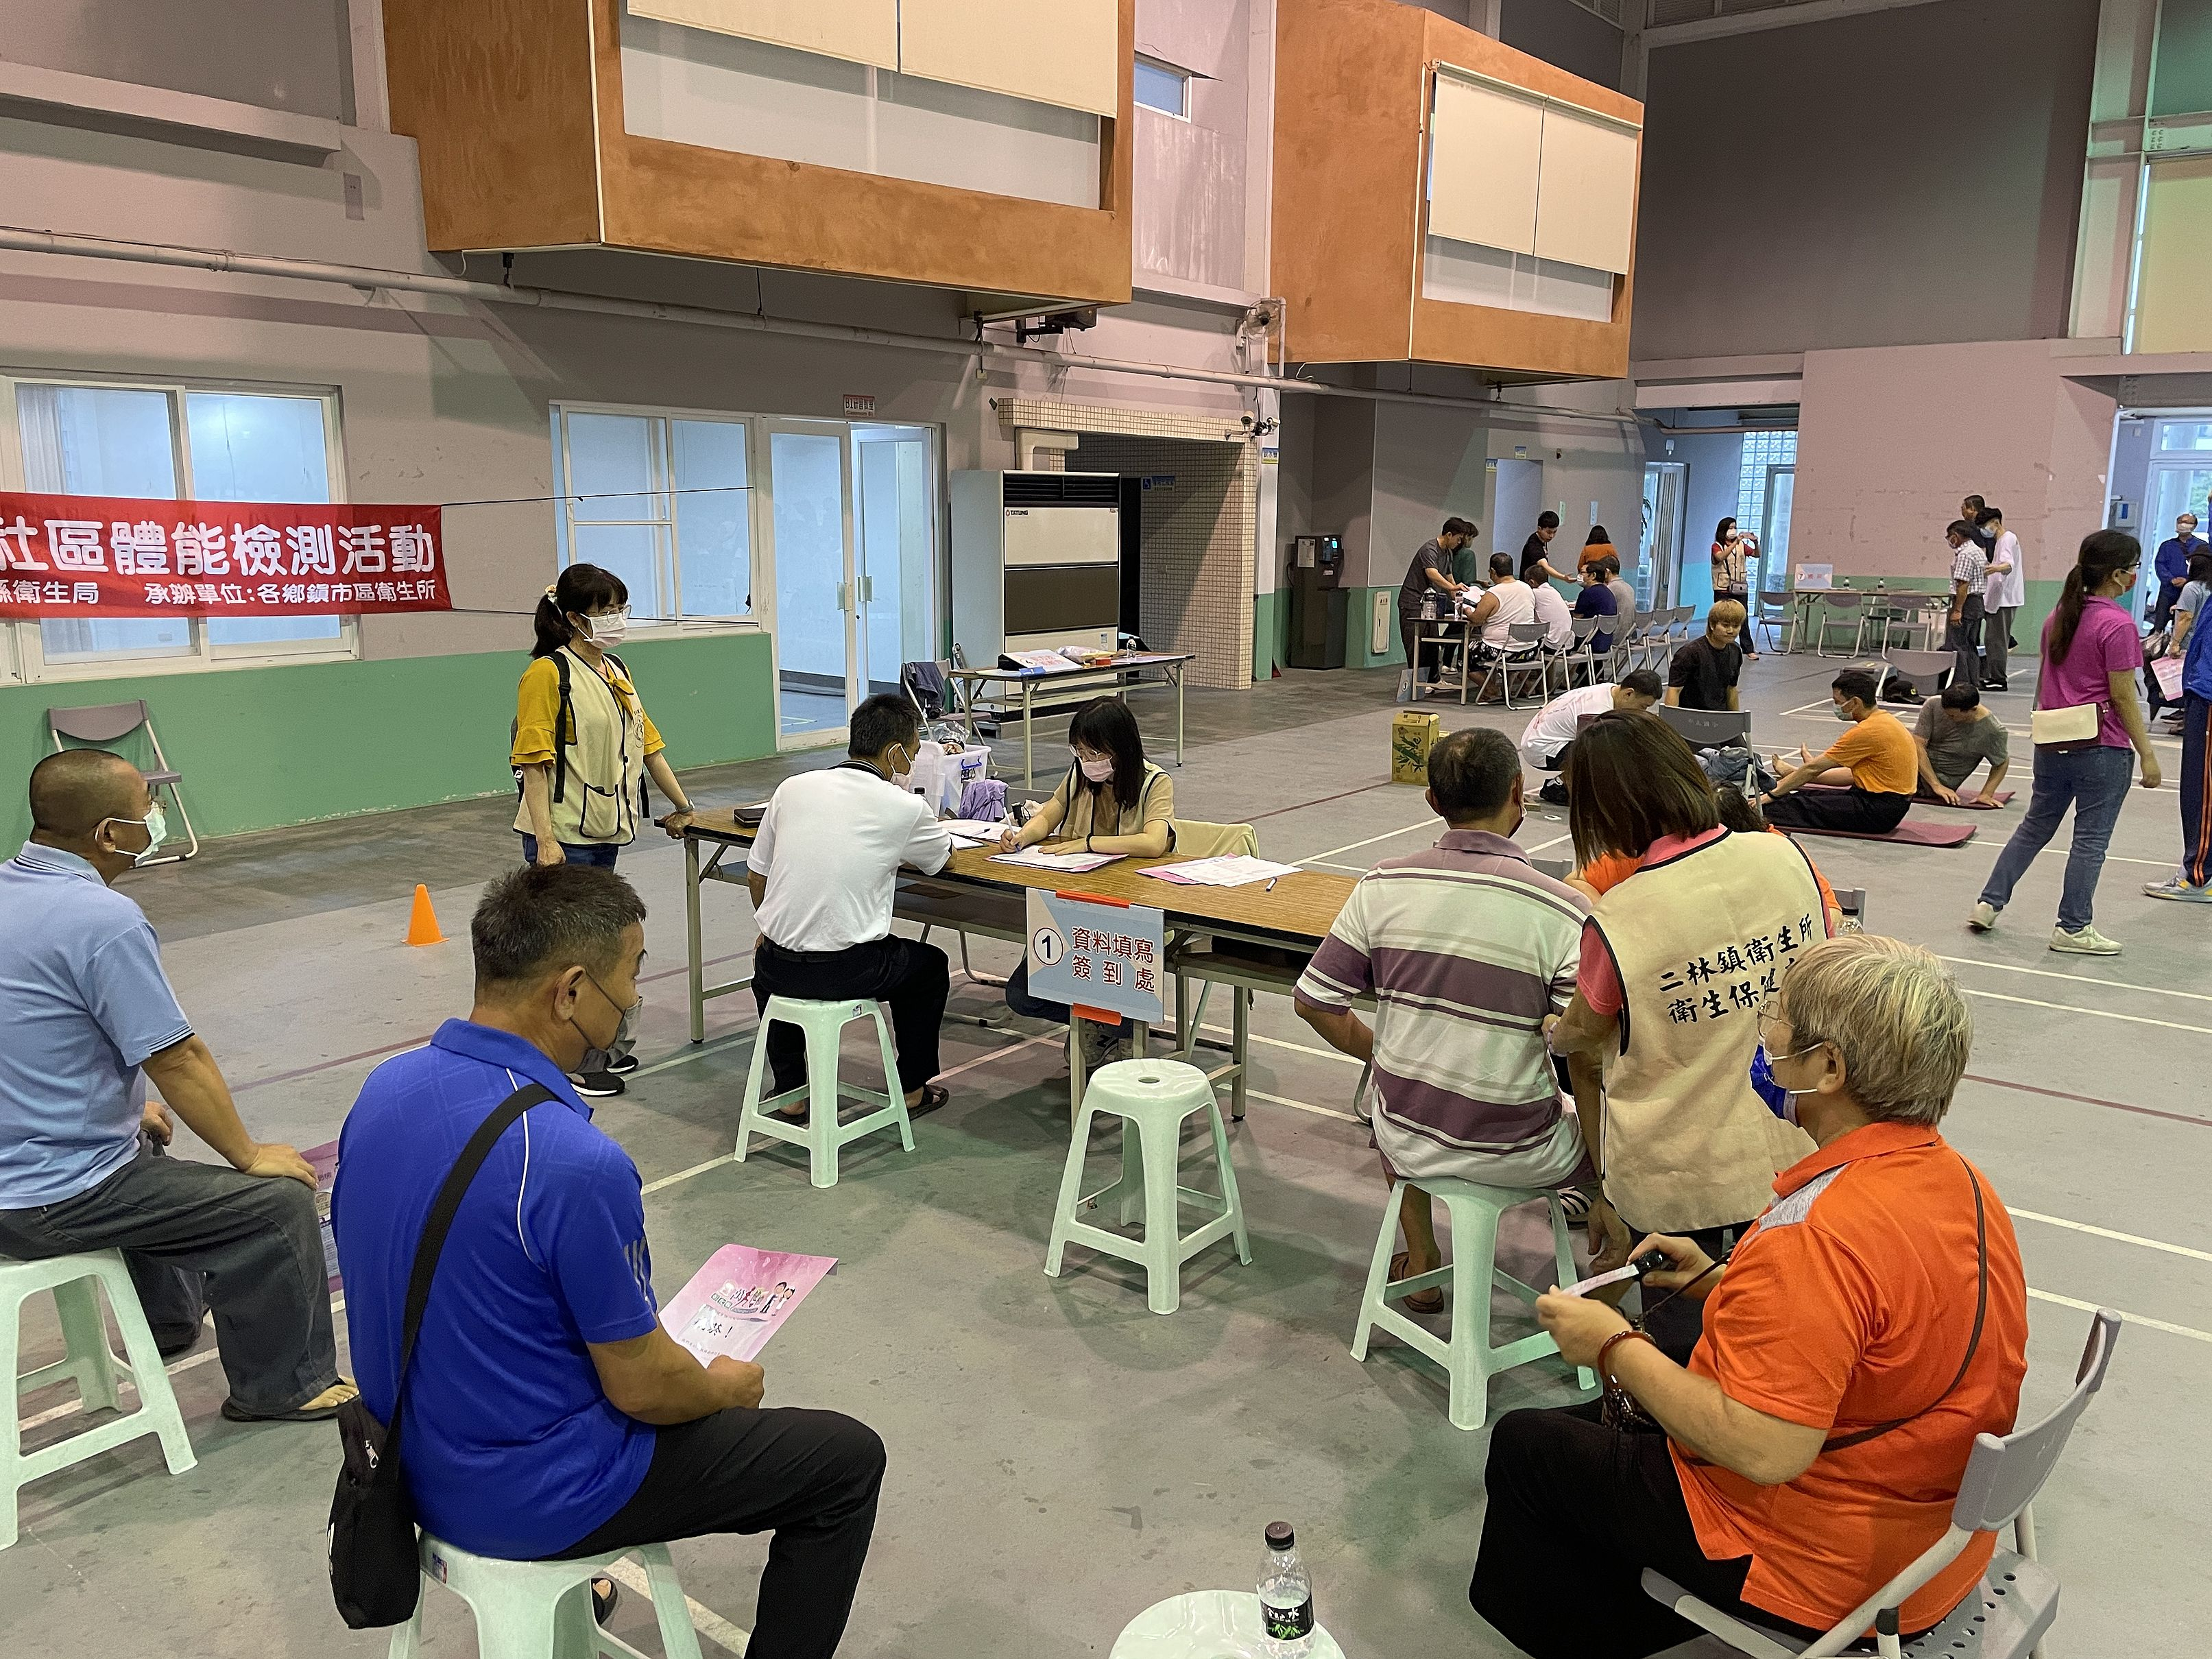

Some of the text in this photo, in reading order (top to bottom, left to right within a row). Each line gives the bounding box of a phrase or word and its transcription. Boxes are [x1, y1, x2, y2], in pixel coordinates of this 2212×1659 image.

[0, 515, 435, 577] 社區體能檢測活動
[1042, 935, 1051, 959] 1
[1072, 927, 1154, 964] 資料填寫
[1659, 913, 1812, 992] 二林鎮衛生所
